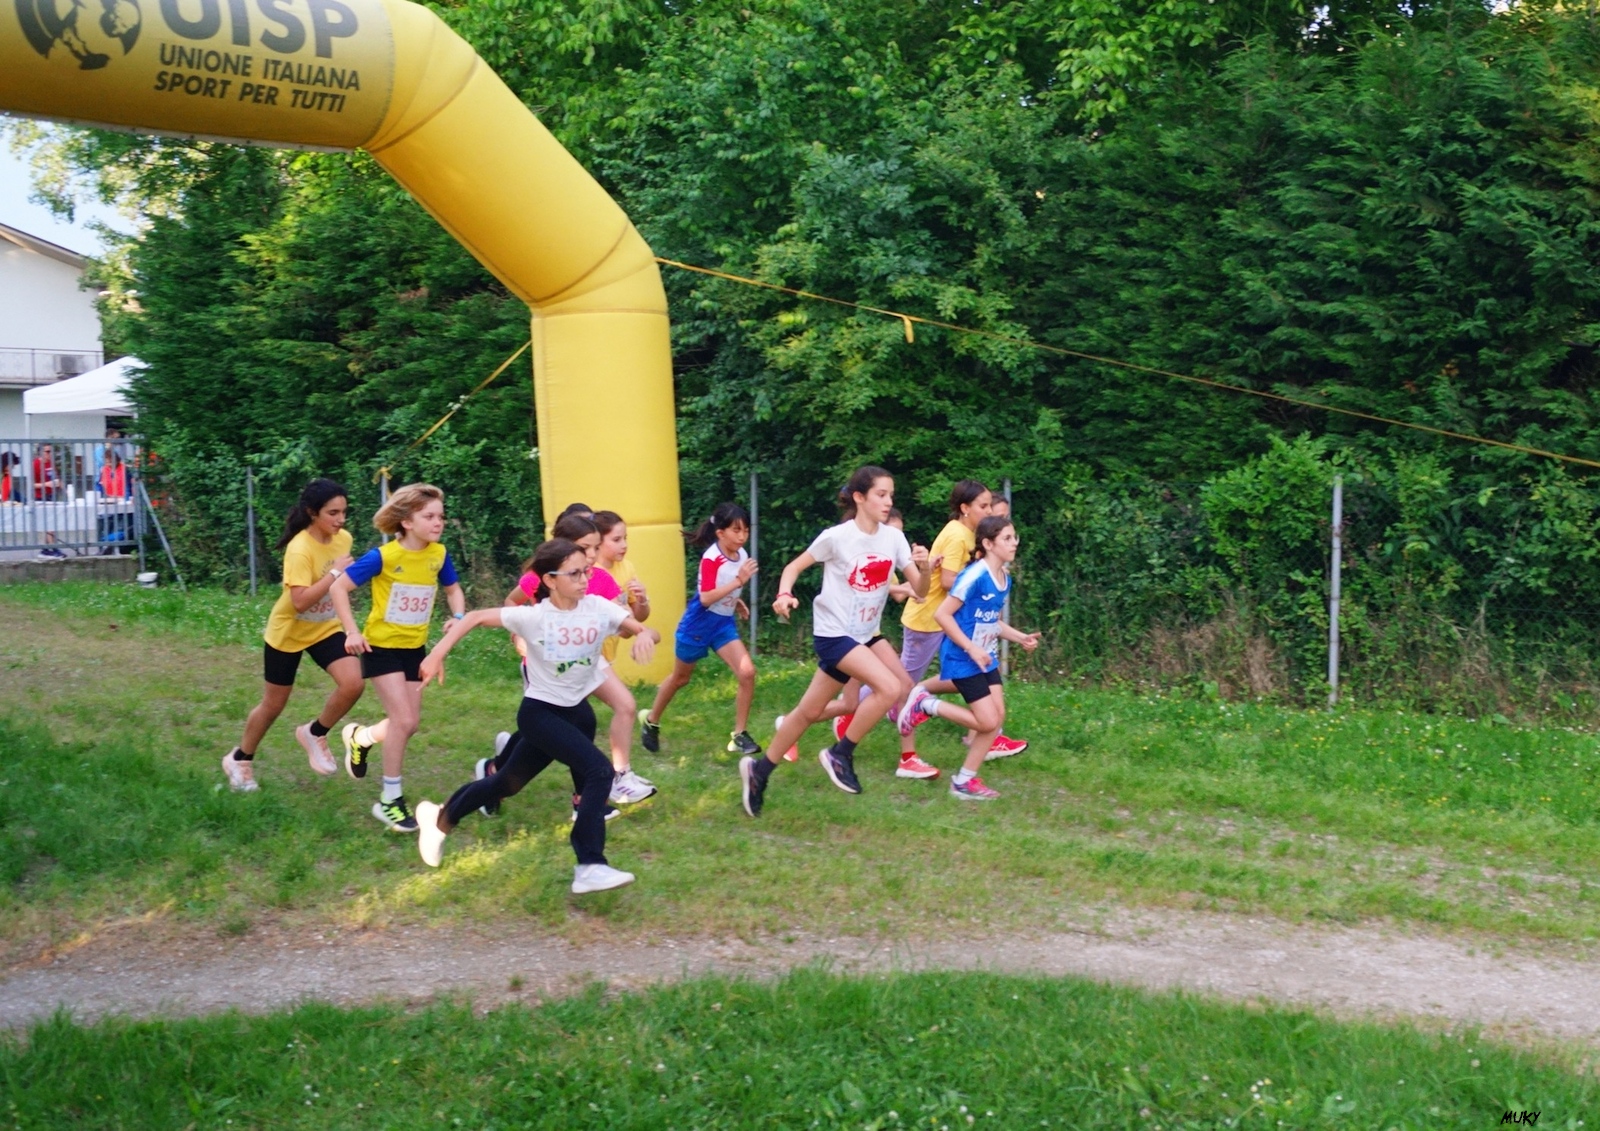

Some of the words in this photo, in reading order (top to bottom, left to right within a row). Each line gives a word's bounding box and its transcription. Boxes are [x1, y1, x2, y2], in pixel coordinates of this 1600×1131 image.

[159, 0, 359, 59] UISP
[159, 43, 254, 77] UNIONE
[263, 58, 361, 91] ITALIANA
[154, 71, 231, 99] SPORT
[239, 82, 280, 106] PER
[290, 89, 347, 113] TUTTI
[398, 596, 430, 613] 335
[557, 627, 599, 646] 330
